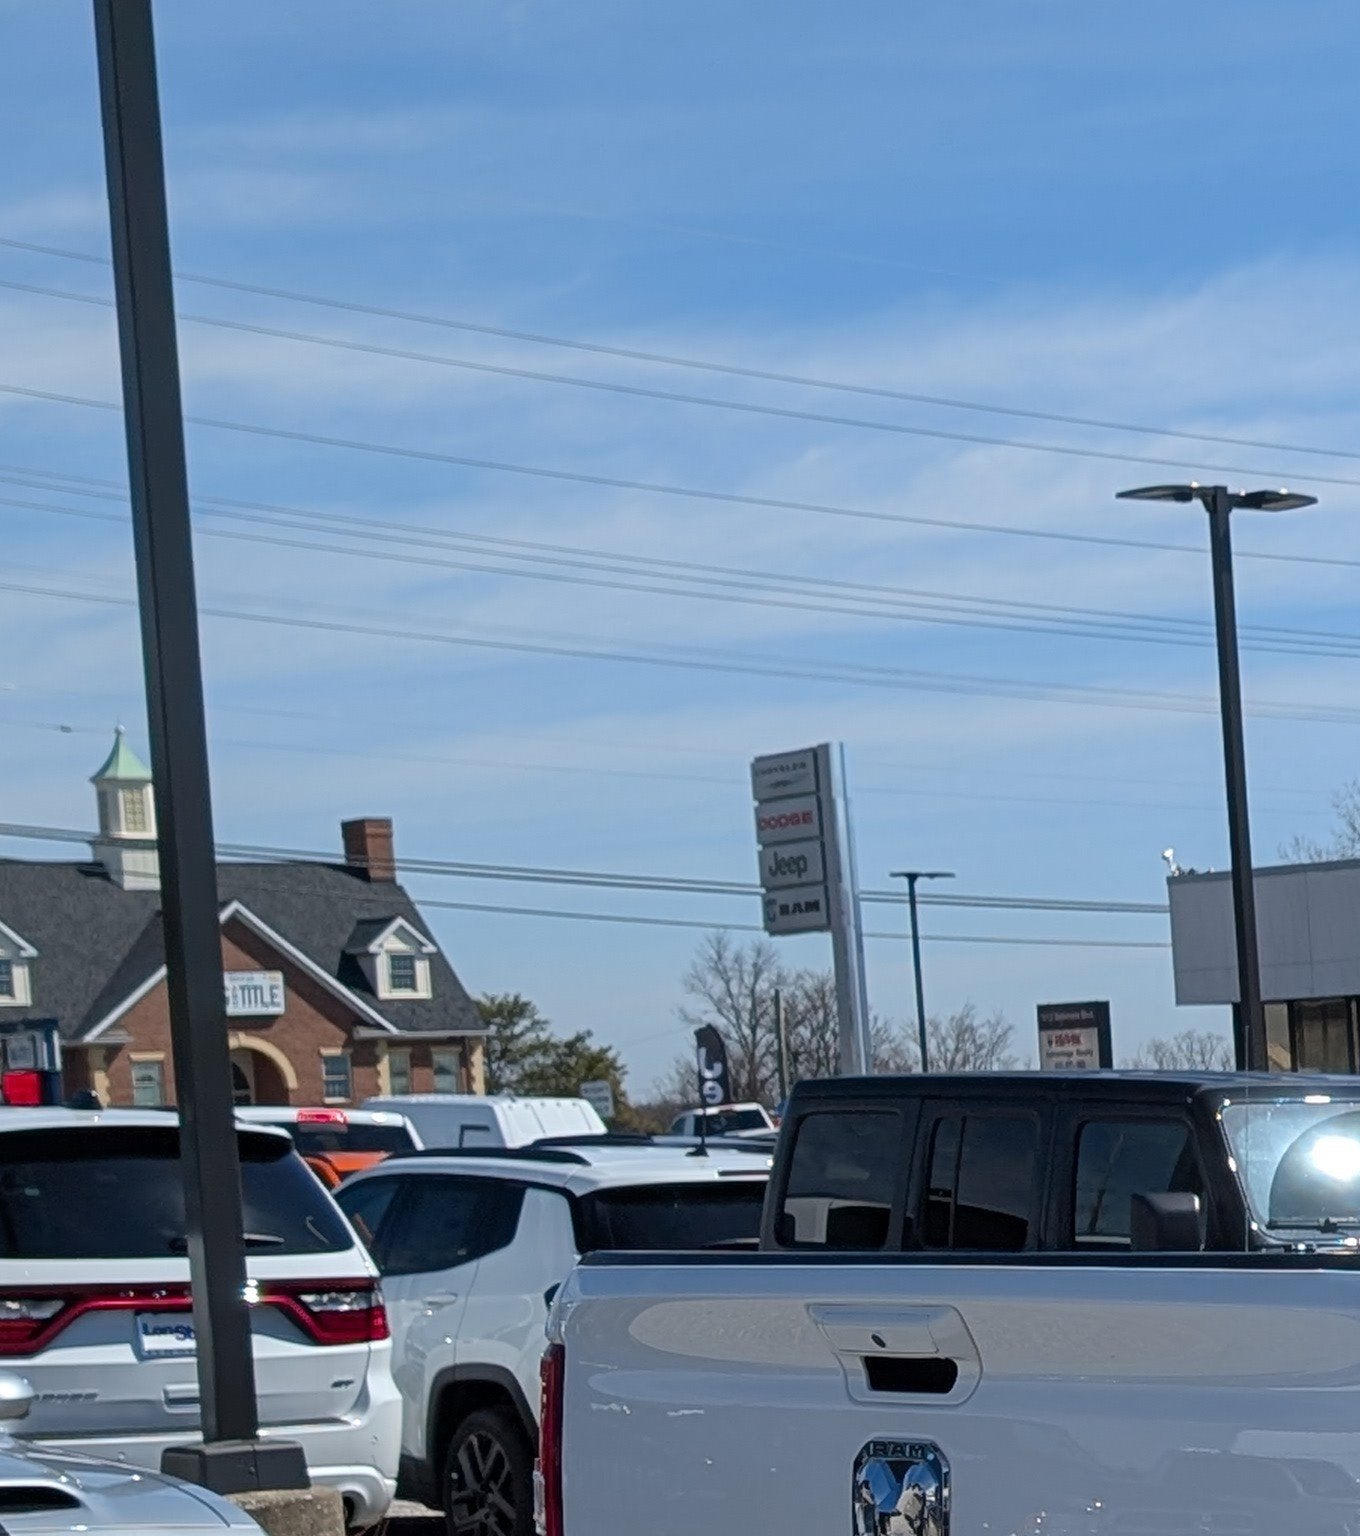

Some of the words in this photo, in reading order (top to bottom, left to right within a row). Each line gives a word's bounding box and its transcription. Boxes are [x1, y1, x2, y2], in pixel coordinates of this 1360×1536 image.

[759, 810, 814, 831] DODGE
[768, 851, 808, 879] Jeep
[779, 900, 821, 917] RAM
[239, 984, 281, 1009] TITLE
[869, 1441, 923, 1458] RAM
